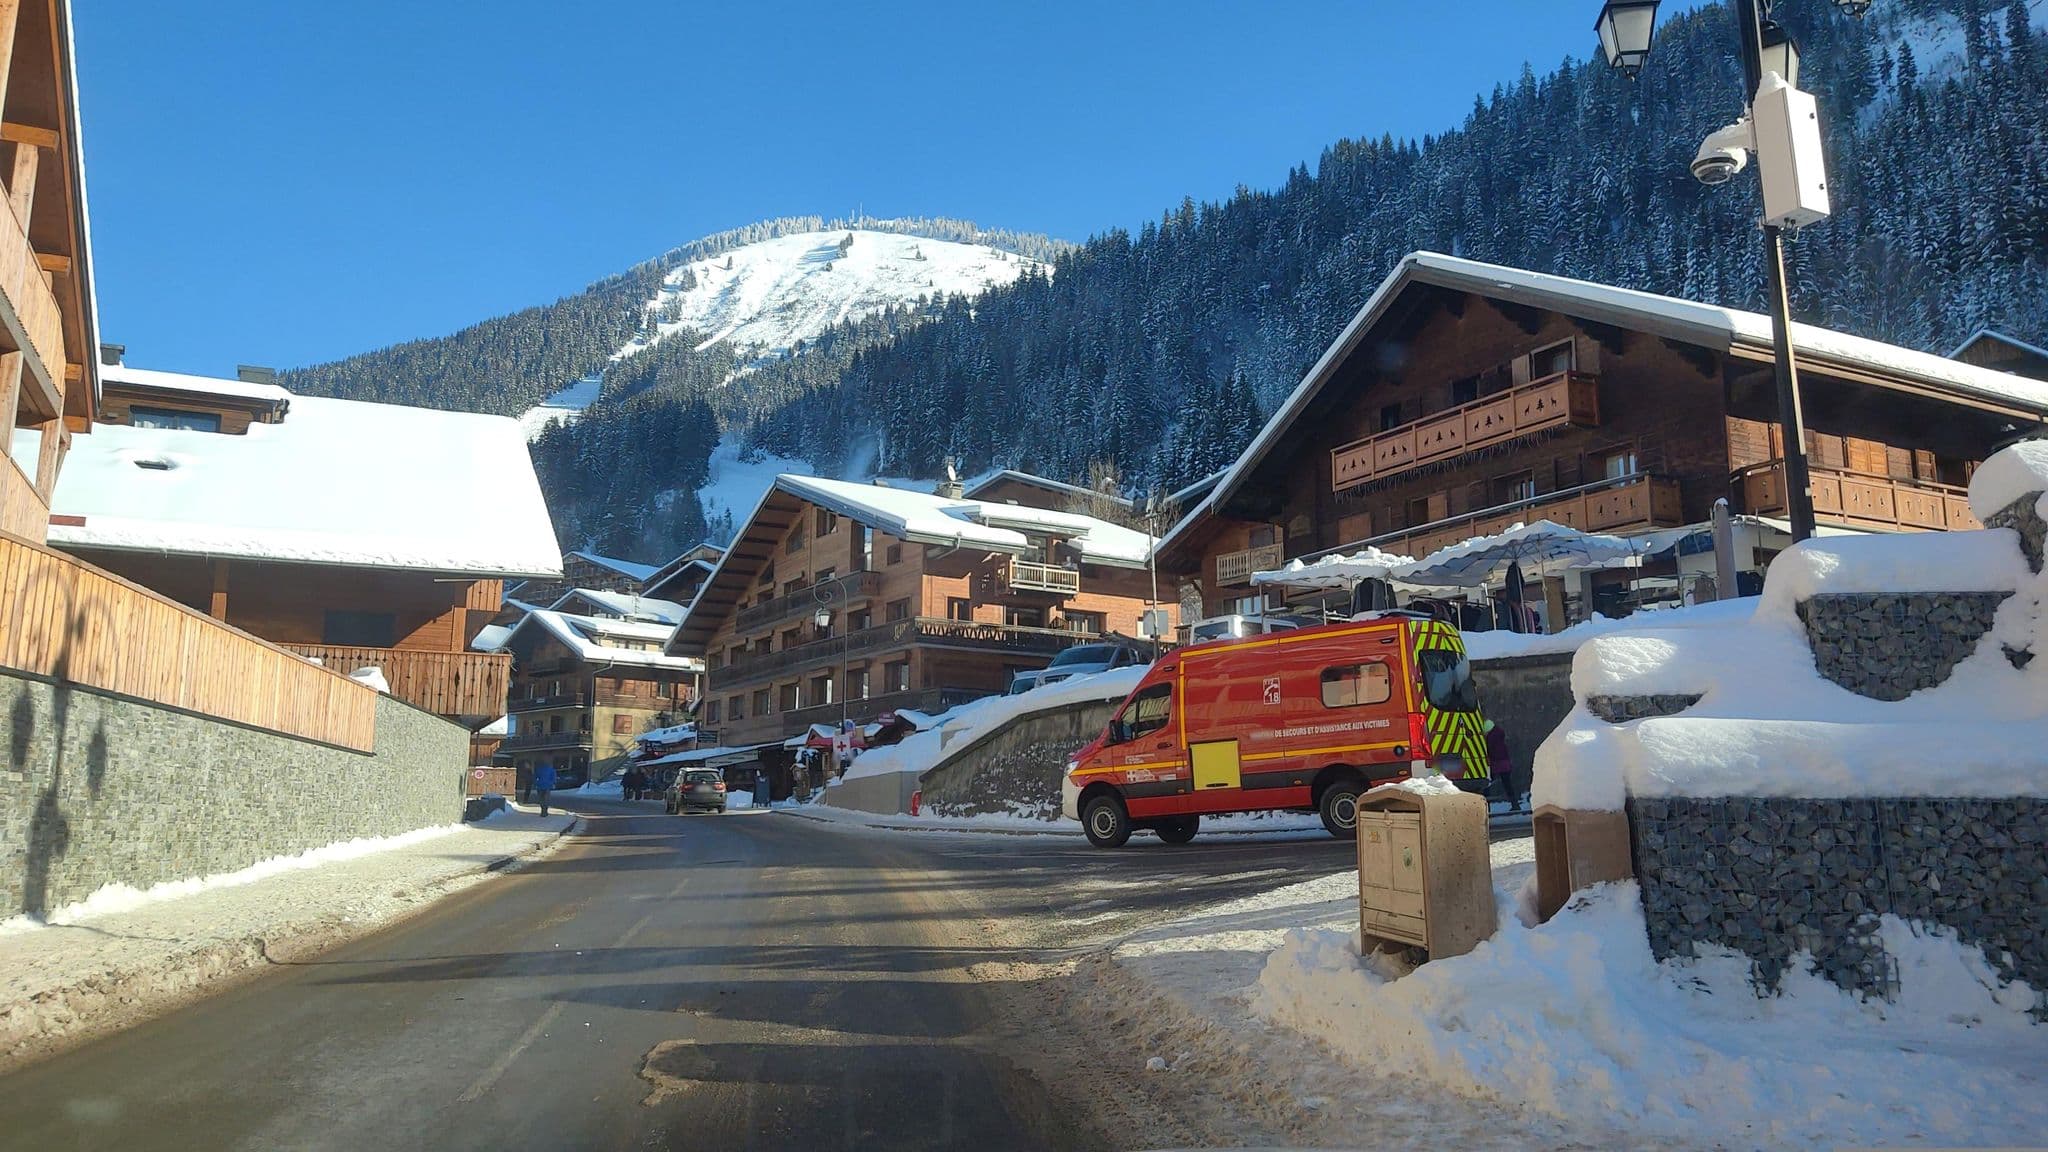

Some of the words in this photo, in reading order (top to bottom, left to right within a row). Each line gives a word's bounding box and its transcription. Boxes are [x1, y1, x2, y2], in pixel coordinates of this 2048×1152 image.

[1268, 691, 1279, 702] 18
[1275, 729, 1282, 738] DE
[1282, 728, 1307, 737] SECOURS
[1307, 727, 1314, 736] ET
[1315, 724, 1351, 735] D'ASSISTANCE
[1352, 721, 1363, 731] AUX
[1364, 719, 1390, 730] VICTIMES
